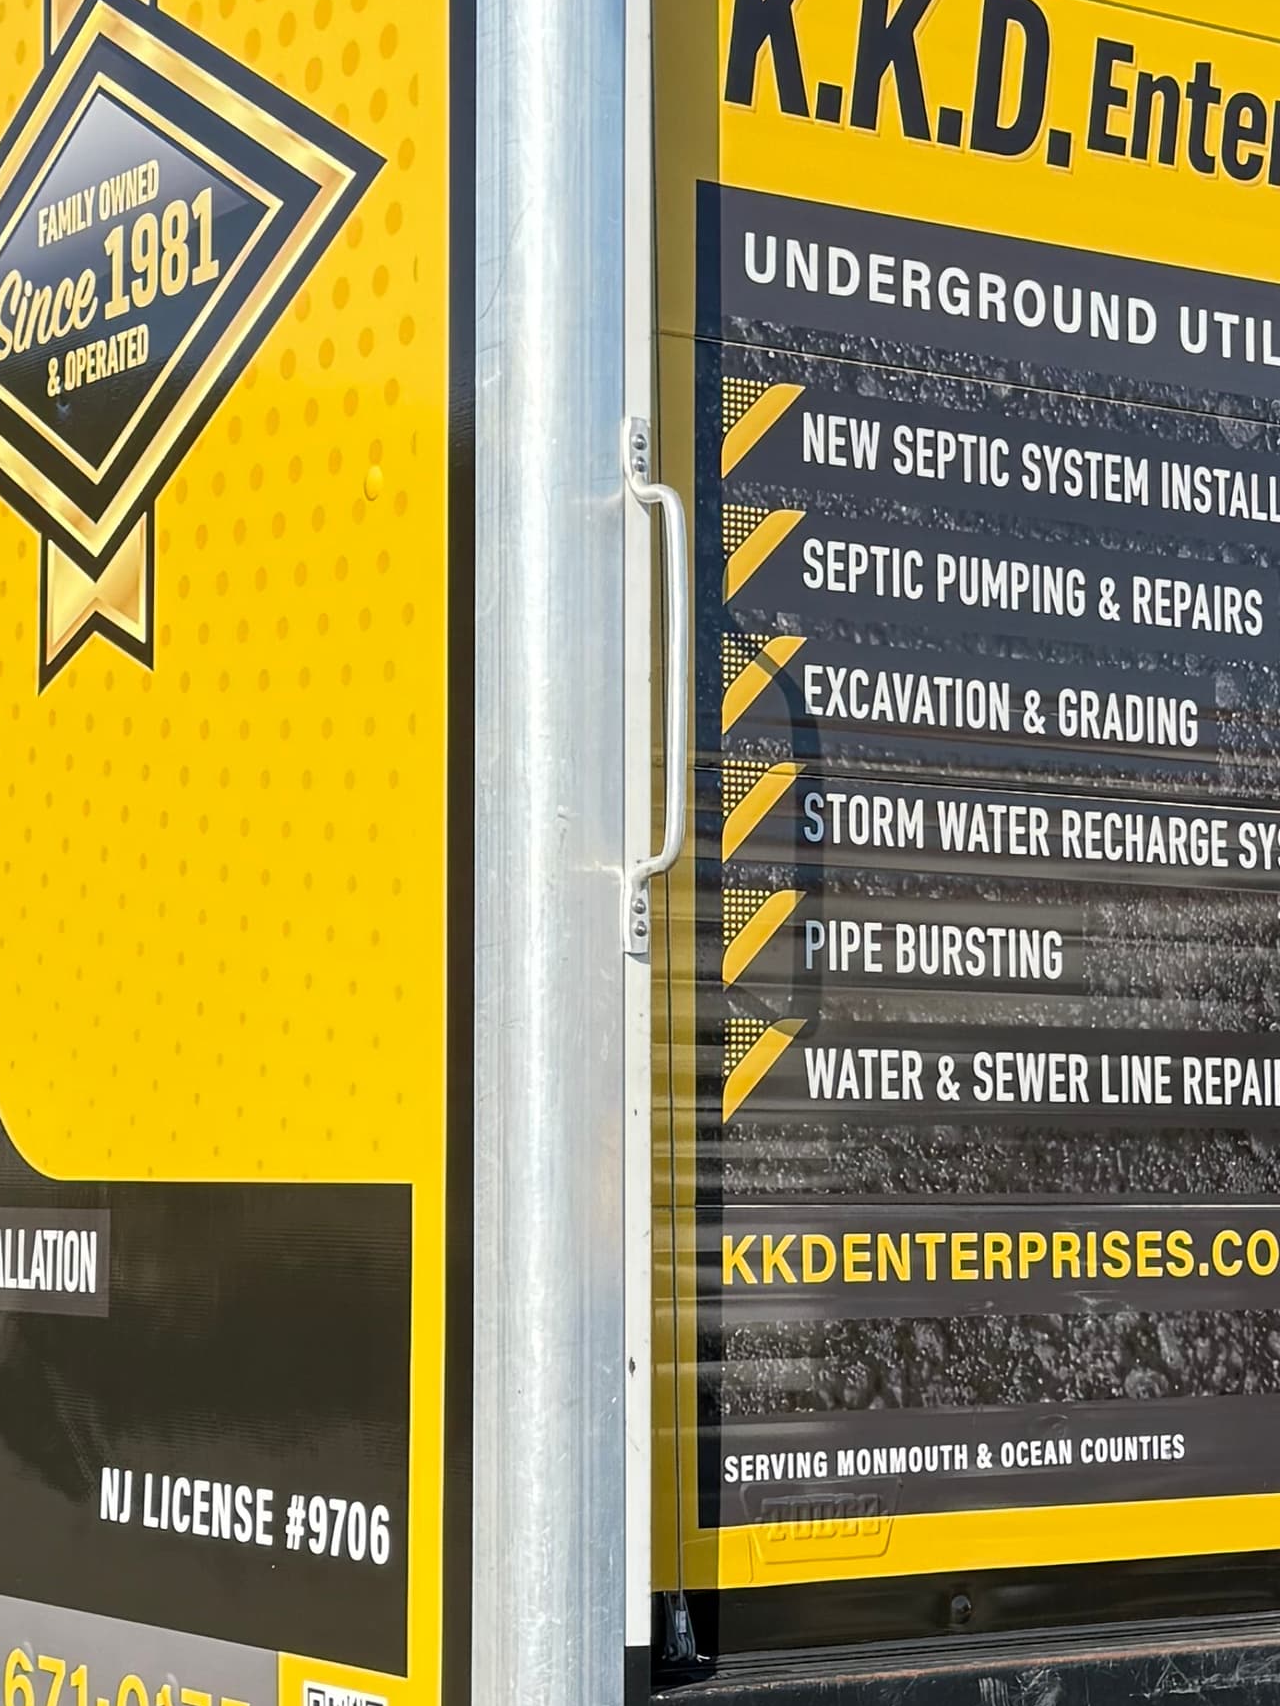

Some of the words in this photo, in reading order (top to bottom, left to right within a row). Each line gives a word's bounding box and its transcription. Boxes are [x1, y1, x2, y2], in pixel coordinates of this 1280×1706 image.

[38, 186, 95, 248] FAMILY
[99, 159, 160, 221] OWNED
[103, 187, 219, 320] 1981
[744, 231, 1158, 345] UNDERGROUND
[47, 357, 61, 397] &
[64, 324, 149, 391] OPERATED
[802, 412, 880, 471] NEW
[893, 424, 1010, 488] SEPTIC
[1021, 443, 1149, 507] SYSTEM
[802, 538, 924, 600] SEPTIC
[936, 553, 1085, 618] PUMPING
[1098, 577, 1121, 622] &
[1133, 576, 1263, 637] REPAIRS
[804, 664, 1010, 732] EXCAVATION
[1022, 689, 1046, 736] &
[1058, 688, 1198, 748] GRADING
[803, 792, 924, 849] STORM
[937, 800, 1050, 858] WATER
[1061, 809, 1228, 867] RECHARGE
[805, 919, 883, 973] PIPE
[896, 924, 1063, 981] BURSTING
[803, 1048, 923, 1100] WATER
[936, 1055, 960, 1101] &
[972, 1052, 1090, 1104] SEWER
[1101, 1055, 1172, 1105] LINE
[723, 1450, 829, 1483] SERVING
[836, 1443, 968, 1478] MONMOUTH
[976, 1444, 992, 1469] &
[1000, 1438, 1073, 1468] OCEAN
[1080, 1433, 1185, 1464] COUNTIES
[100, 1467, 133, 1522] NJ
[142, 1472, 274, 1547] LICENSE
[285, 1494, 390, 1566] #9706
